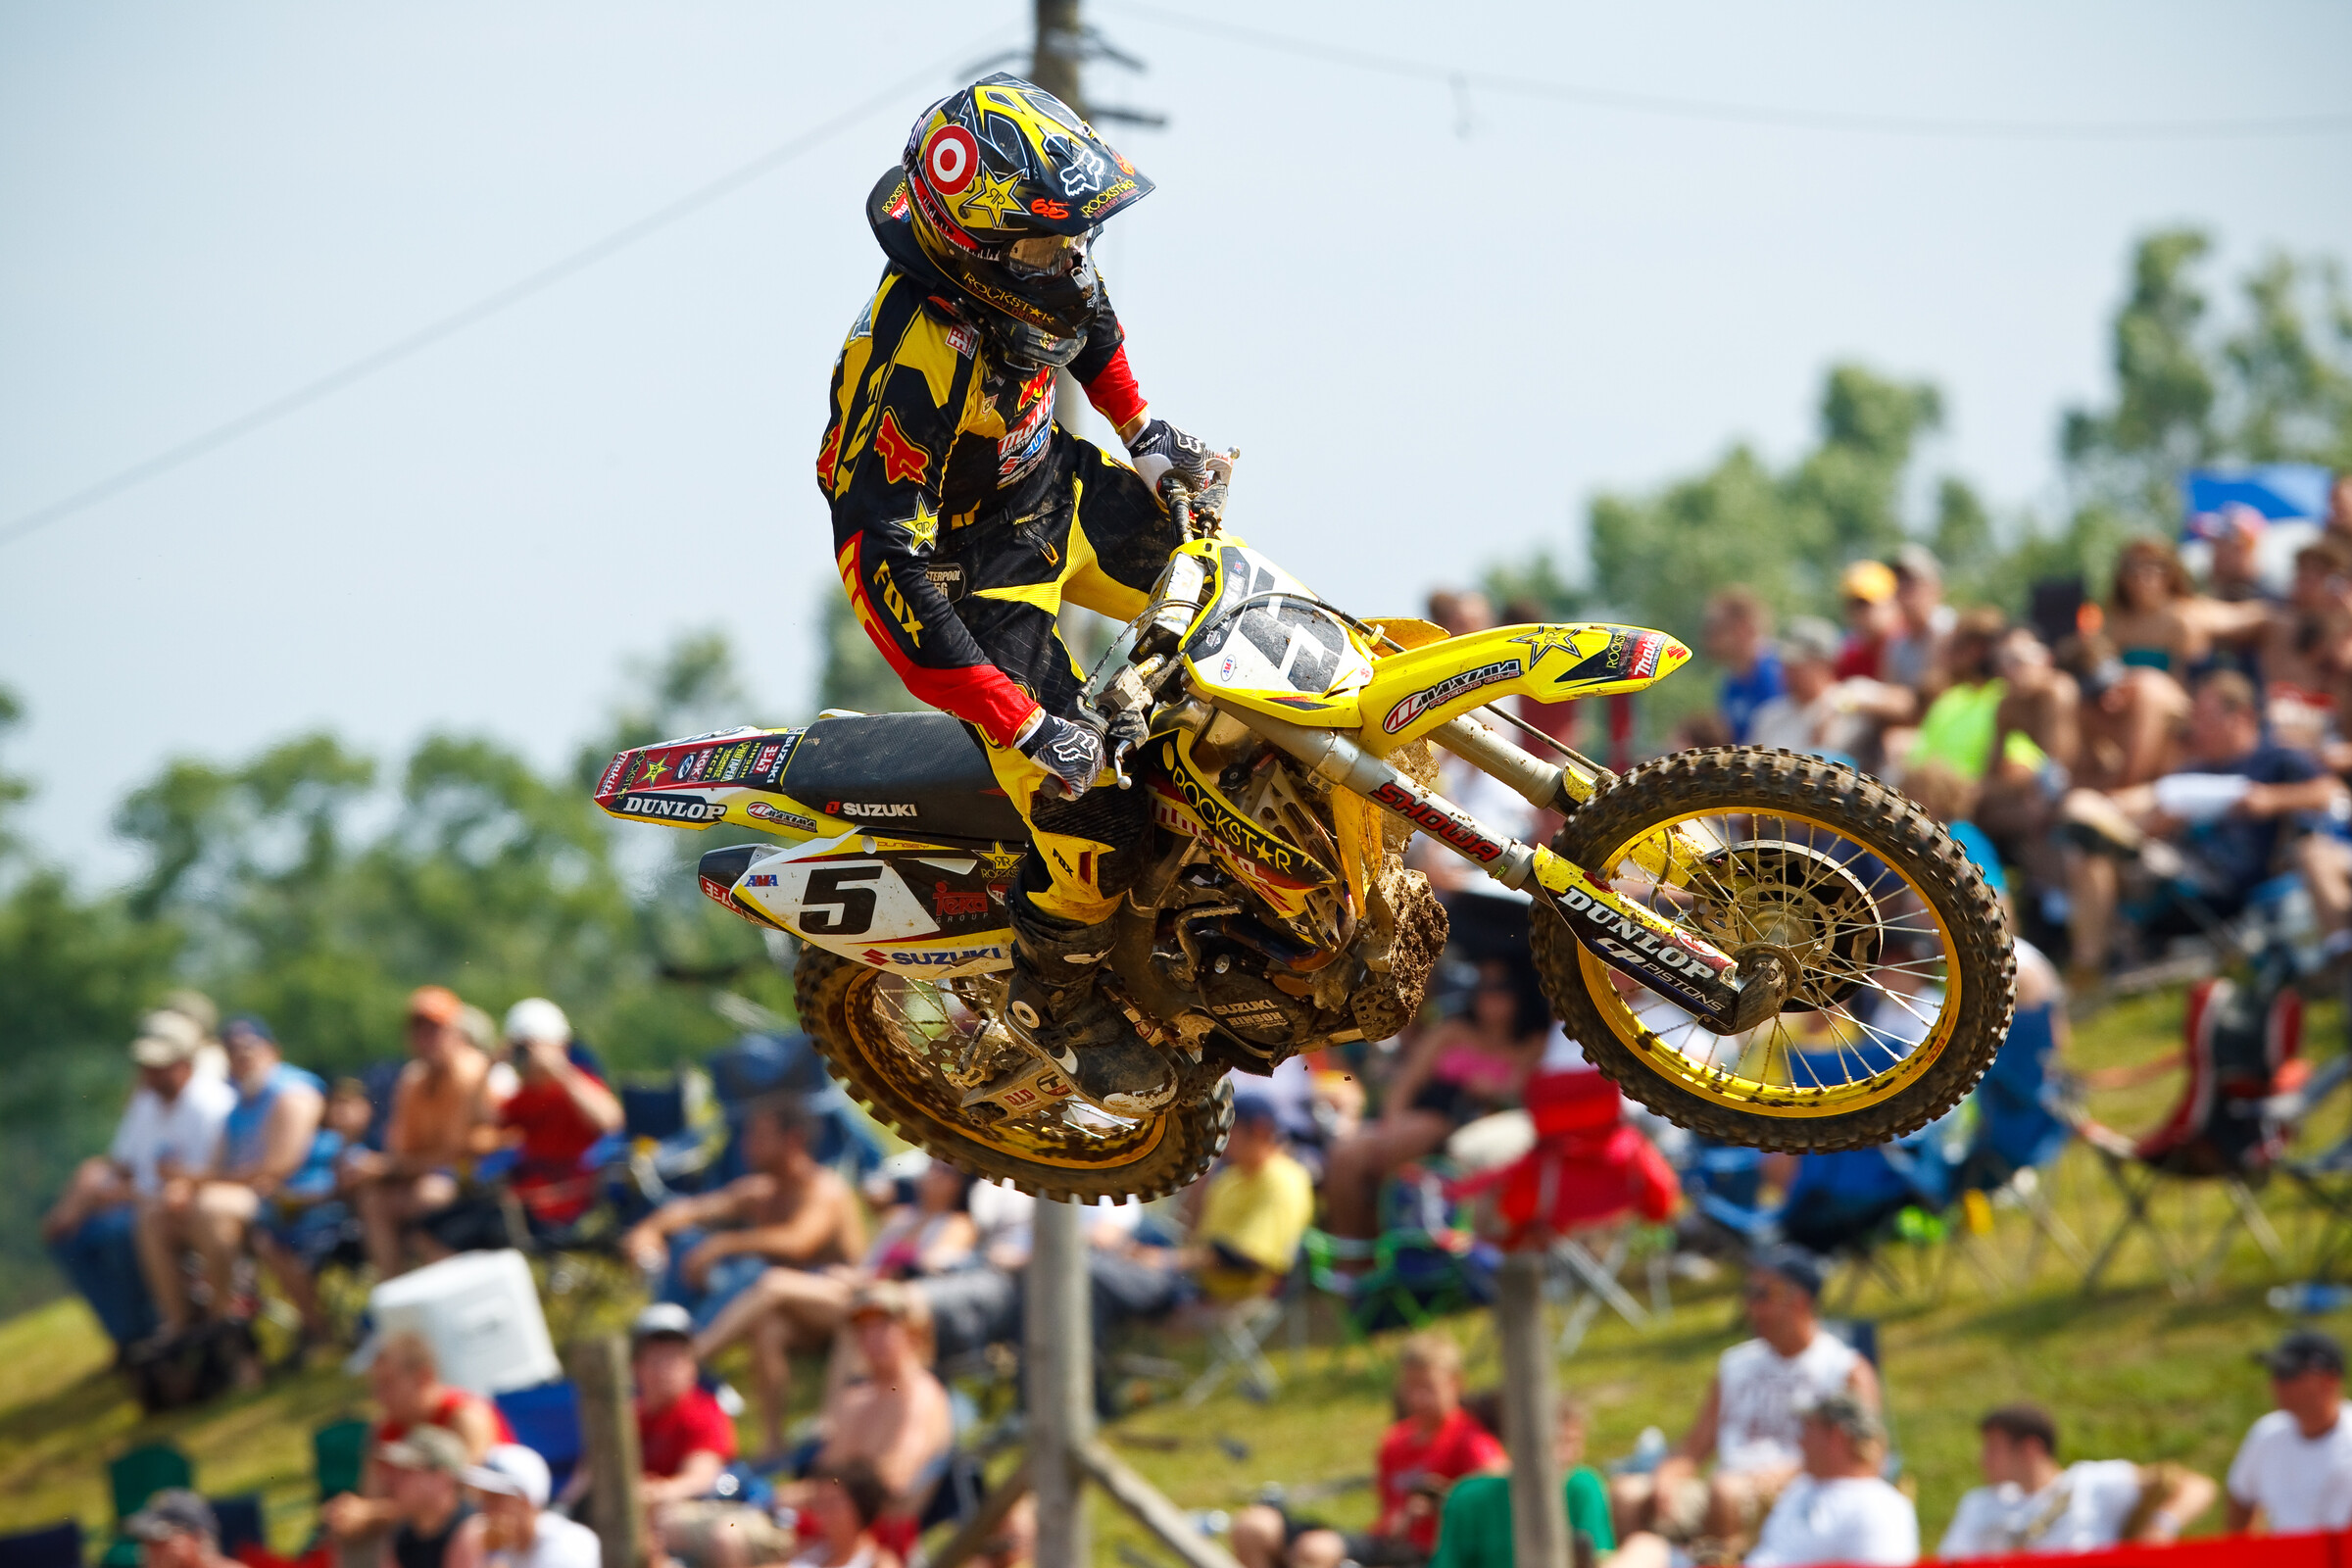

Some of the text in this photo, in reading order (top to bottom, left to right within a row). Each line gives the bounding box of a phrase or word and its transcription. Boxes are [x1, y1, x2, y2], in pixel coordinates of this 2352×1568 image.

[873, 559, 924, 649] FOX
[691, 750, 711, 776] NGK
[703, 747, 724, 780] EXCEL
[766, 735, 796, 783] SUZUKI
[623, 797, 726, 819] DUNLOP
[843, 802, 917, 817] SUZUKI
[1369, 781, 1503, 862] SHOWA
[1053, 848, 1074, 878] FOX
[744, 874, 779, 887] AMA
[799, 865, 883, 935] 5
[935, 912, 989, 924] GROUP
[1557, 887, 1716, 980] DUNLOP
[1643, 962, 1726, 1012] PISTONS
[1211, 1000, 1279, 1015] SUZUKI
[1226, 1011, 1285, 1026] HINSON
